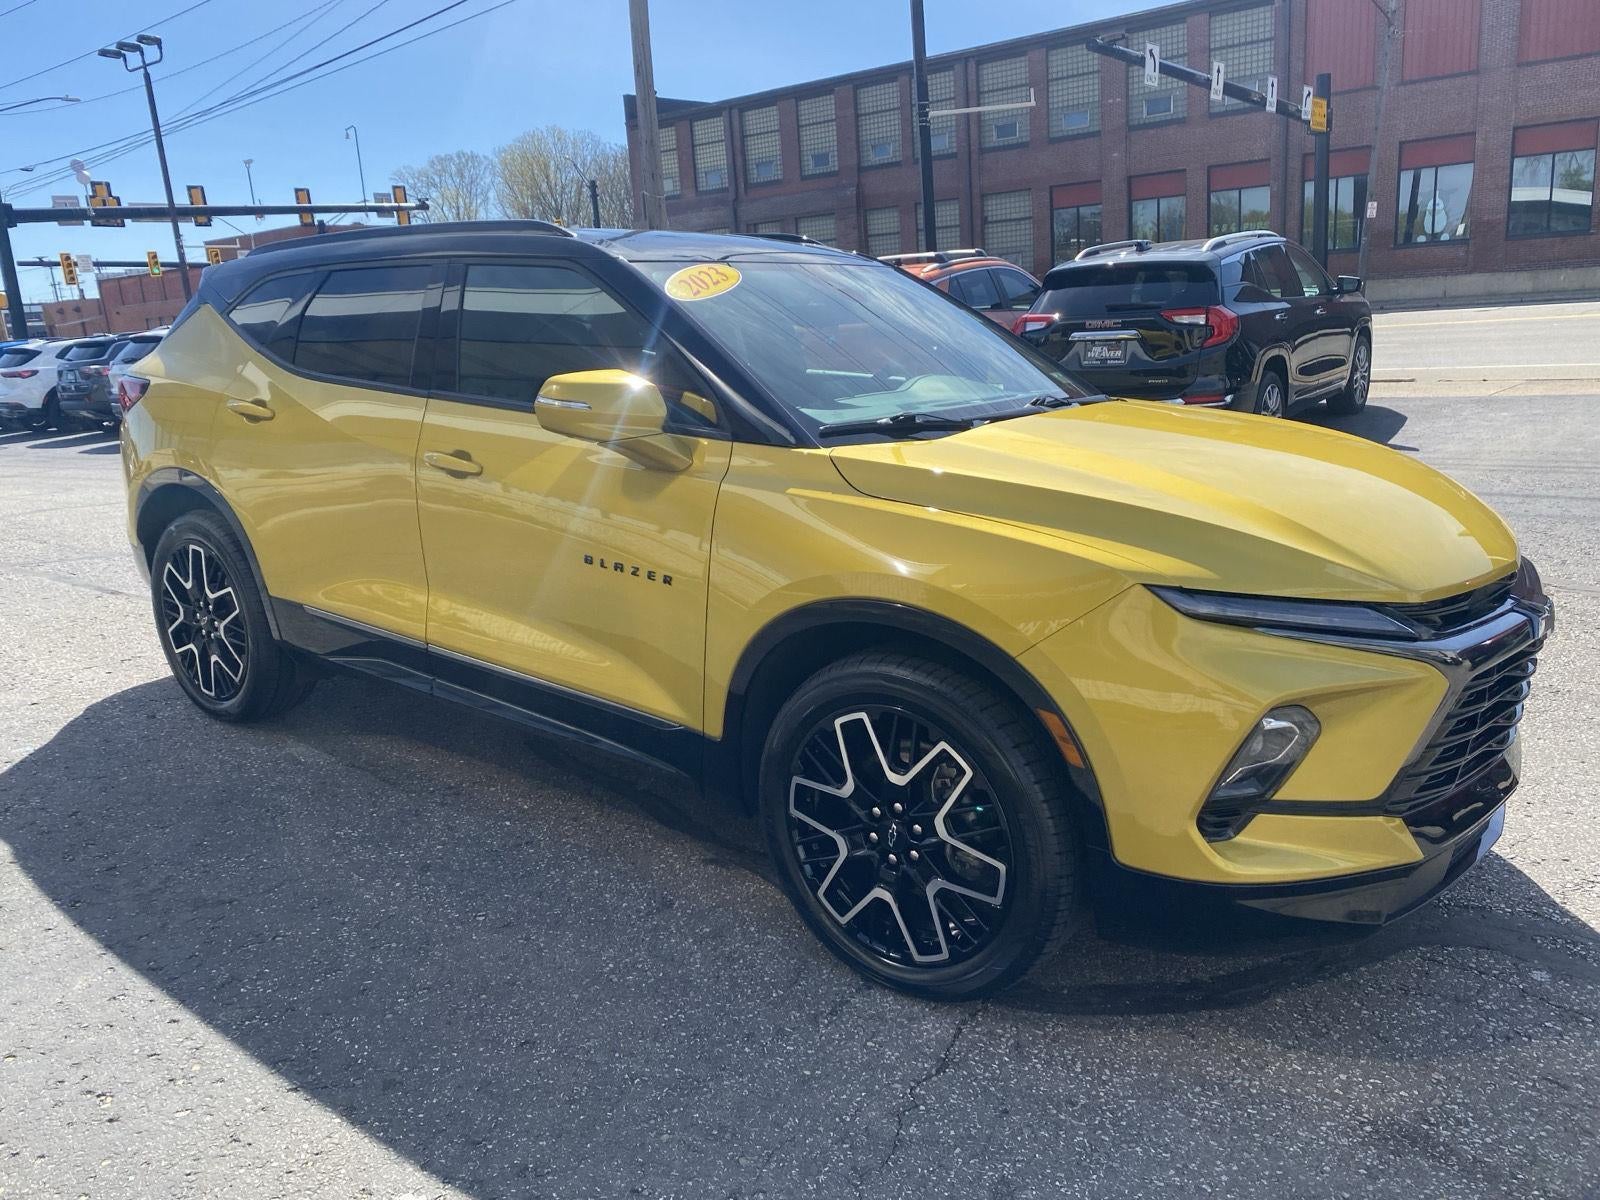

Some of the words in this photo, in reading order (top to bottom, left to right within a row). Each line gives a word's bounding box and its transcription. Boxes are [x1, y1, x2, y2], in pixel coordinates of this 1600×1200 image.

[678, 266, 729, 297] 2023
[1085, 319, 1121, 328] GMC
[1087, 349, 1122, 358] WEAVER
[583, 554, 673, 587] BLAZER
